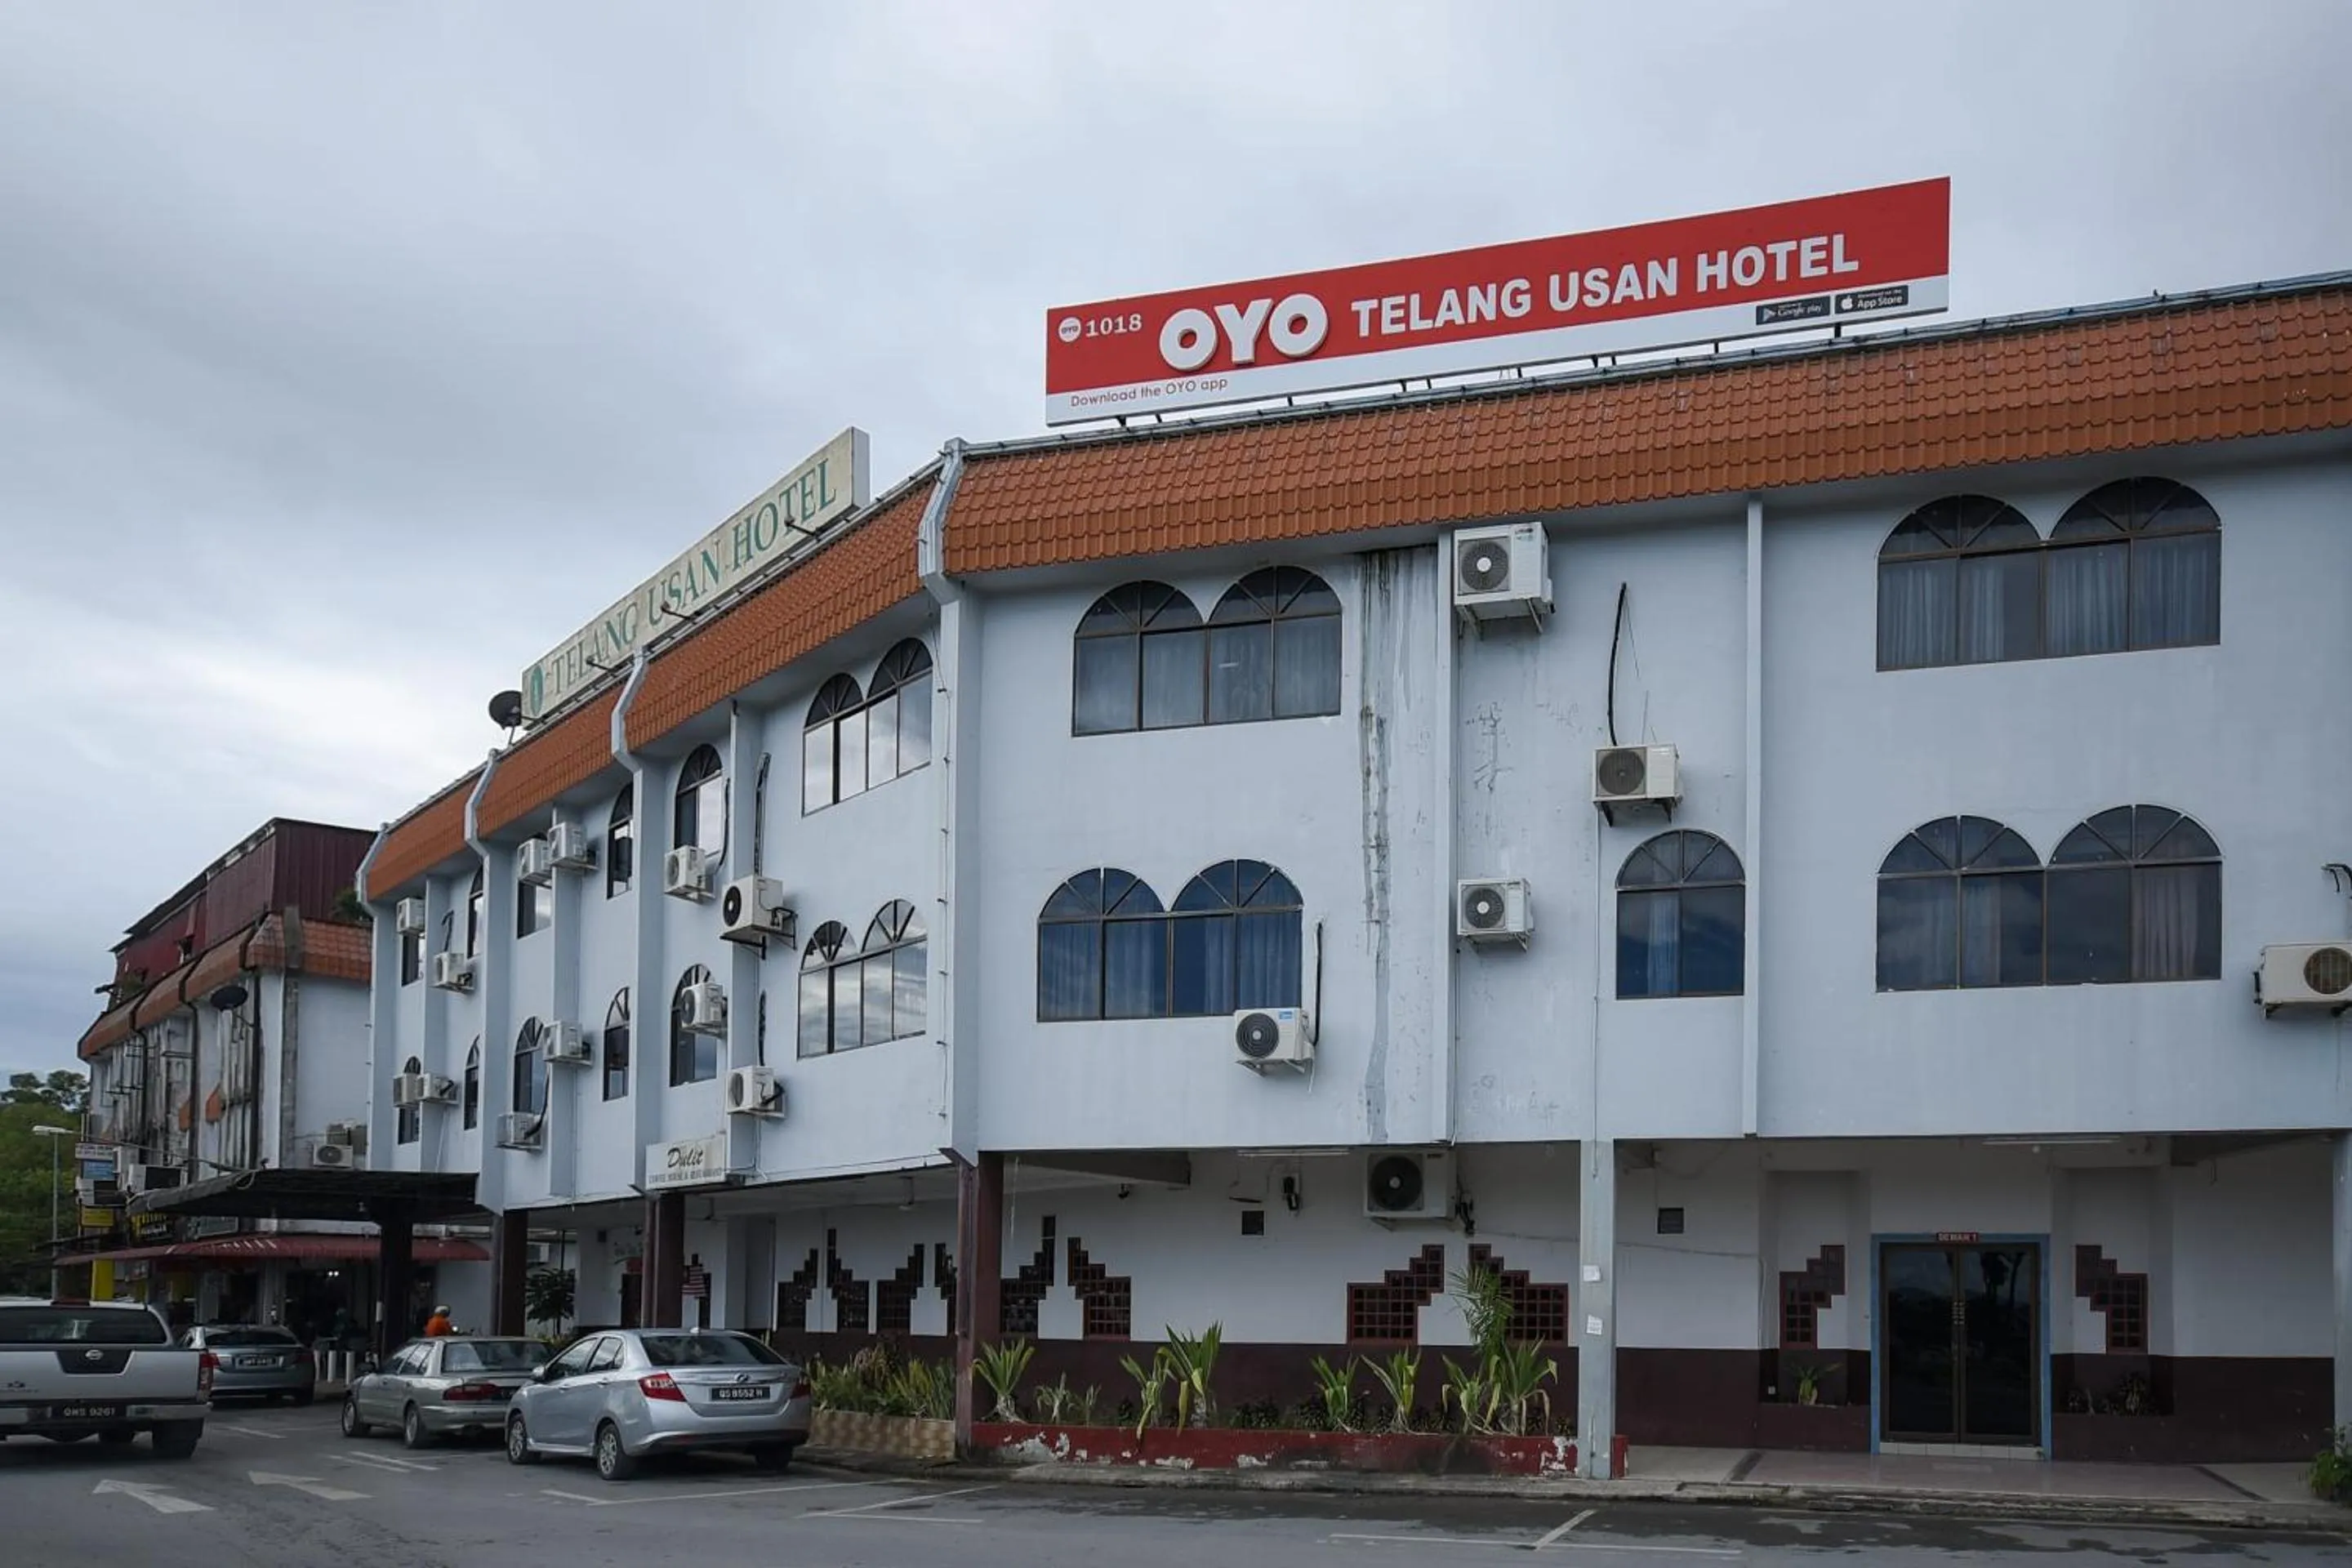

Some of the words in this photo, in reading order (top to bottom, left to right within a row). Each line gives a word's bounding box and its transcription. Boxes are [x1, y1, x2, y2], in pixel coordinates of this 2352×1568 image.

[1160, 293, 1330, 372] OYO
[1351, 278, 1533, 337] TELANG
[1548, 257, 1678, 312] USAN
[1696, 234, 1860, 292] HOTEL
[1857, 299, 1877, 310] App
[1878, 296, 1904, 306] Store
[1085, 314, 1143, 337] 1018
[1071, 390, 1136, 407] Download
[1141, 387, 1161, 398] the
[1165, 380, 1197, 395] OYO
[1200, 378, 1228, 391] app
[551, 602, 638, 694] TELANG
[648, 539, 720, 626] USAN
[731, 457, 837, 571] HOTEL
[667, 1147, 703, 1169] Dulit
